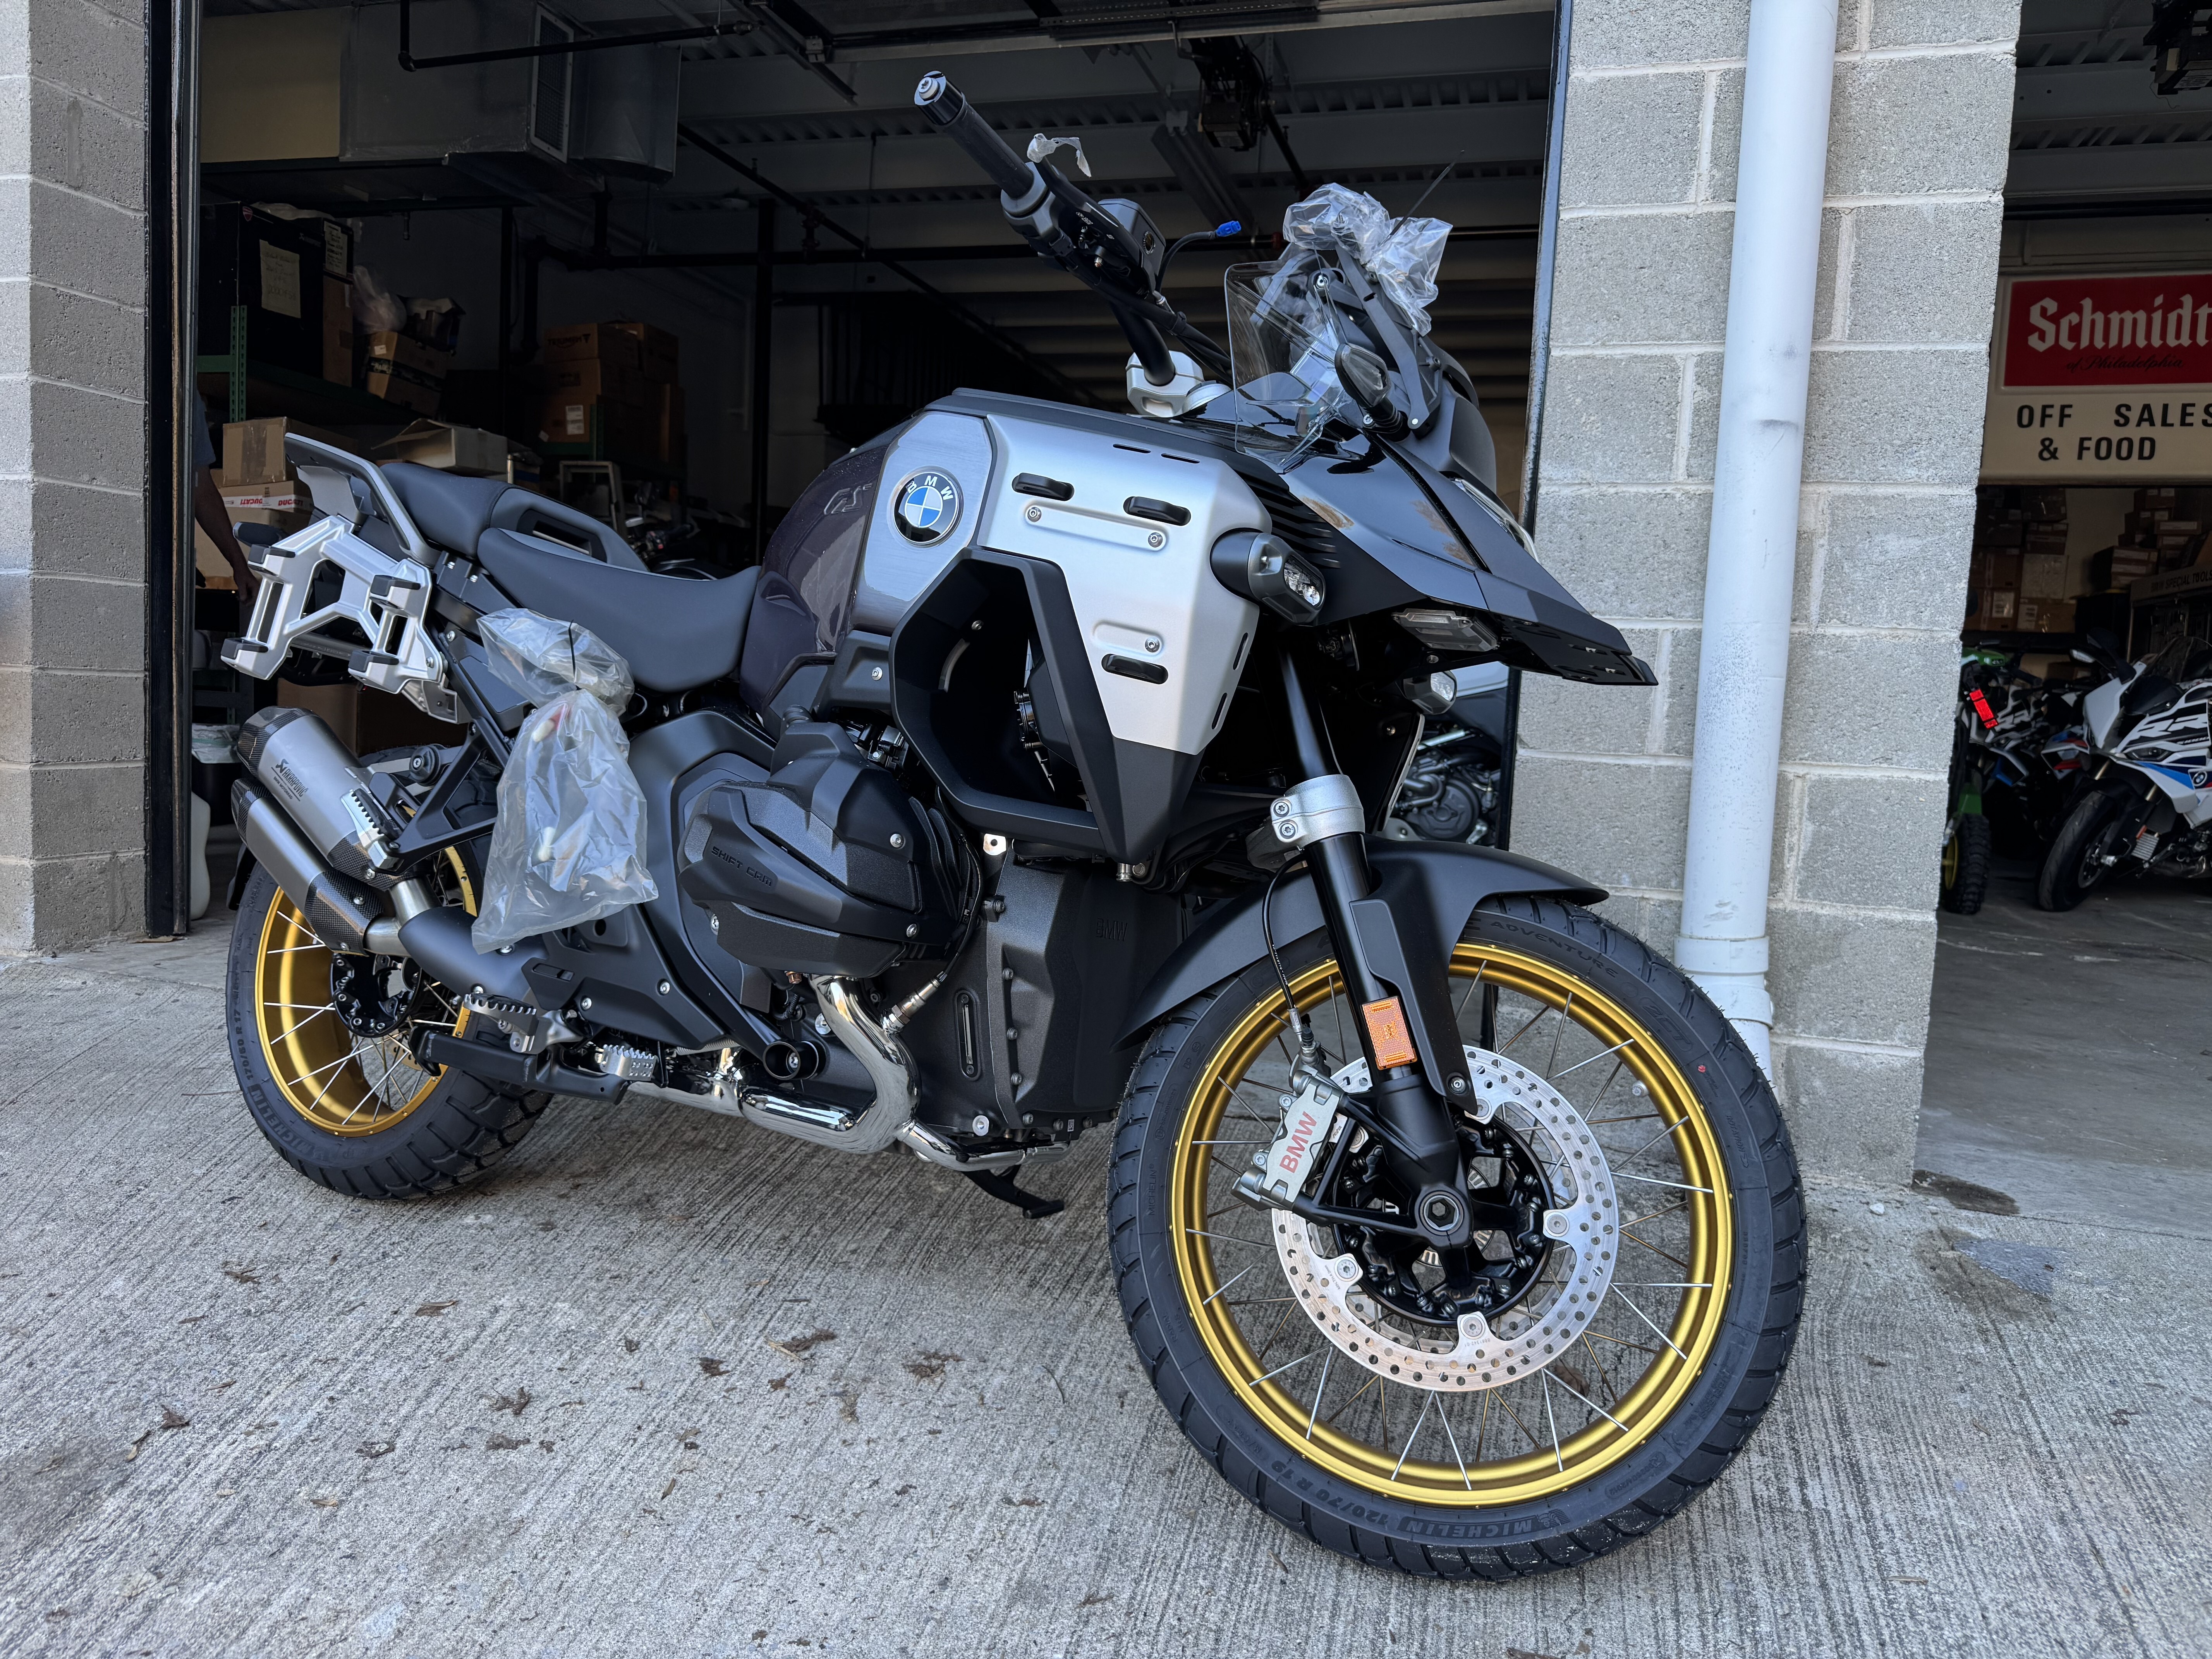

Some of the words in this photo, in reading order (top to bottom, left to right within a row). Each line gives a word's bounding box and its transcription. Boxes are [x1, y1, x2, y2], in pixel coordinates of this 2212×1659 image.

[2027, 294, 2212, 352] Schmidt
[2066, 356, 2083, 371] of
[2082, 354, 2184, 371] Philadelphia
[2016, 404, 2073, 428] OFF
[2114, 403, 2212, 427] SALES
[2038, 437, 2059, 461] &
[2077, 436, 2156, 460] FOOD
[905, 475, 954, 500] BMW
[2166, 575, 2190, 589] SPECIAL
[711, 846, 743, 869] SHIFT
[1096, 917, 1128, 941] BMW
[1490, 921, 1619, 978] ADVENTURE
[234, 1009, 242, 1022] 17
[235, 1026, 243, 1034] R
[234, 1039, 253, 1081] 170/60
[253, 1091, 315, 1154] MICHELIN
[1725, 1115, 1745, 1152] ROTATION
[1279, 1111, 1317, 1173] BMW
[1162, 1312, 1178, 1342] RADIAL
[1271, 1461, 1294, 1480] 19
[1296, 1477, 1313, 1491] R
[1316, 1488, 1388, 1526] 120/70
[1407, 1519, 1532, 1538] MICHELIN
